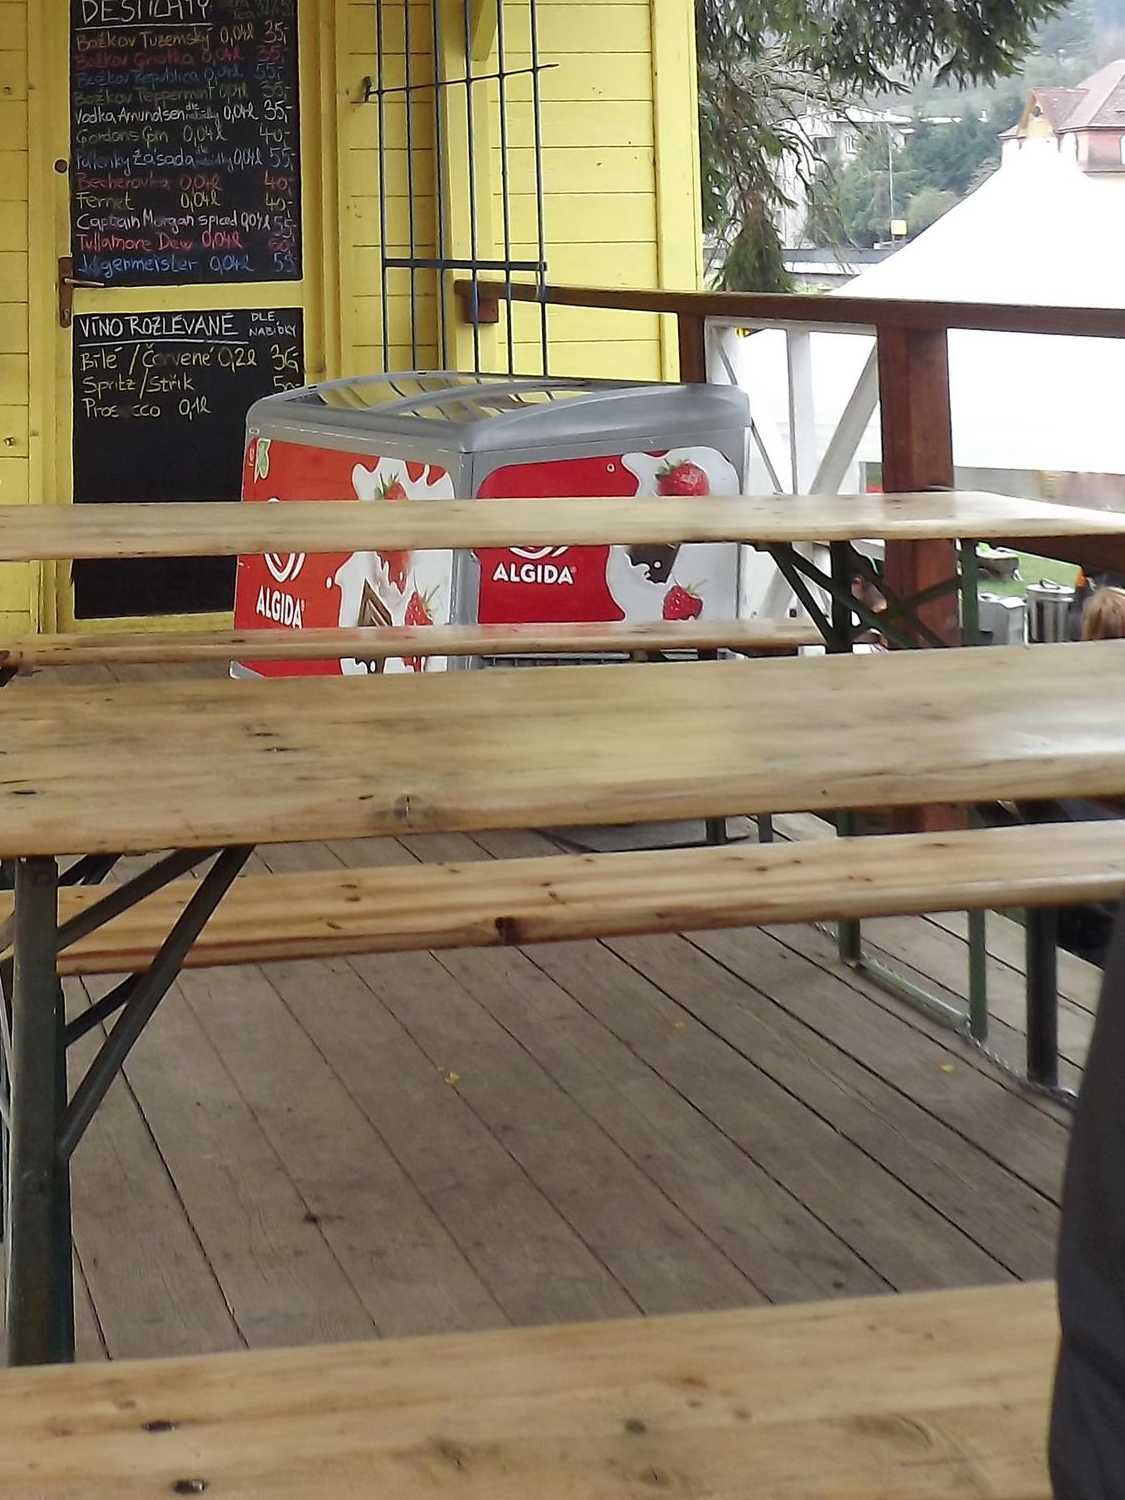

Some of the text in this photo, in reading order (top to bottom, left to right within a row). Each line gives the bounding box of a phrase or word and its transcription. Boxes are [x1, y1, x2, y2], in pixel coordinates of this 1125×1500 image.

[76, 30, 135, 51] Božkov
[75, 103, 117, 125] Vodka
[117, 105, 185, 124] Amundsen
[76, 190, 135, 211] Fernet
[198, 209, 238, 231] spiced
[76, 233, 153, 250] Tullamore
[156, 232, 193, 250] Dew
[77, 253, 199, 279] Jgermeister
[79, 312, 239, 338] VÍNO ROZLÉVANÉ
[251, 312, 276, 323] DLE
[248, 320, 297, 338] NABÍDKY
[81, 397, 162, 419] Proscco
[492, 562, 574, 585] ALGIDA
[255, 584, 303, 629] ALGIDA
